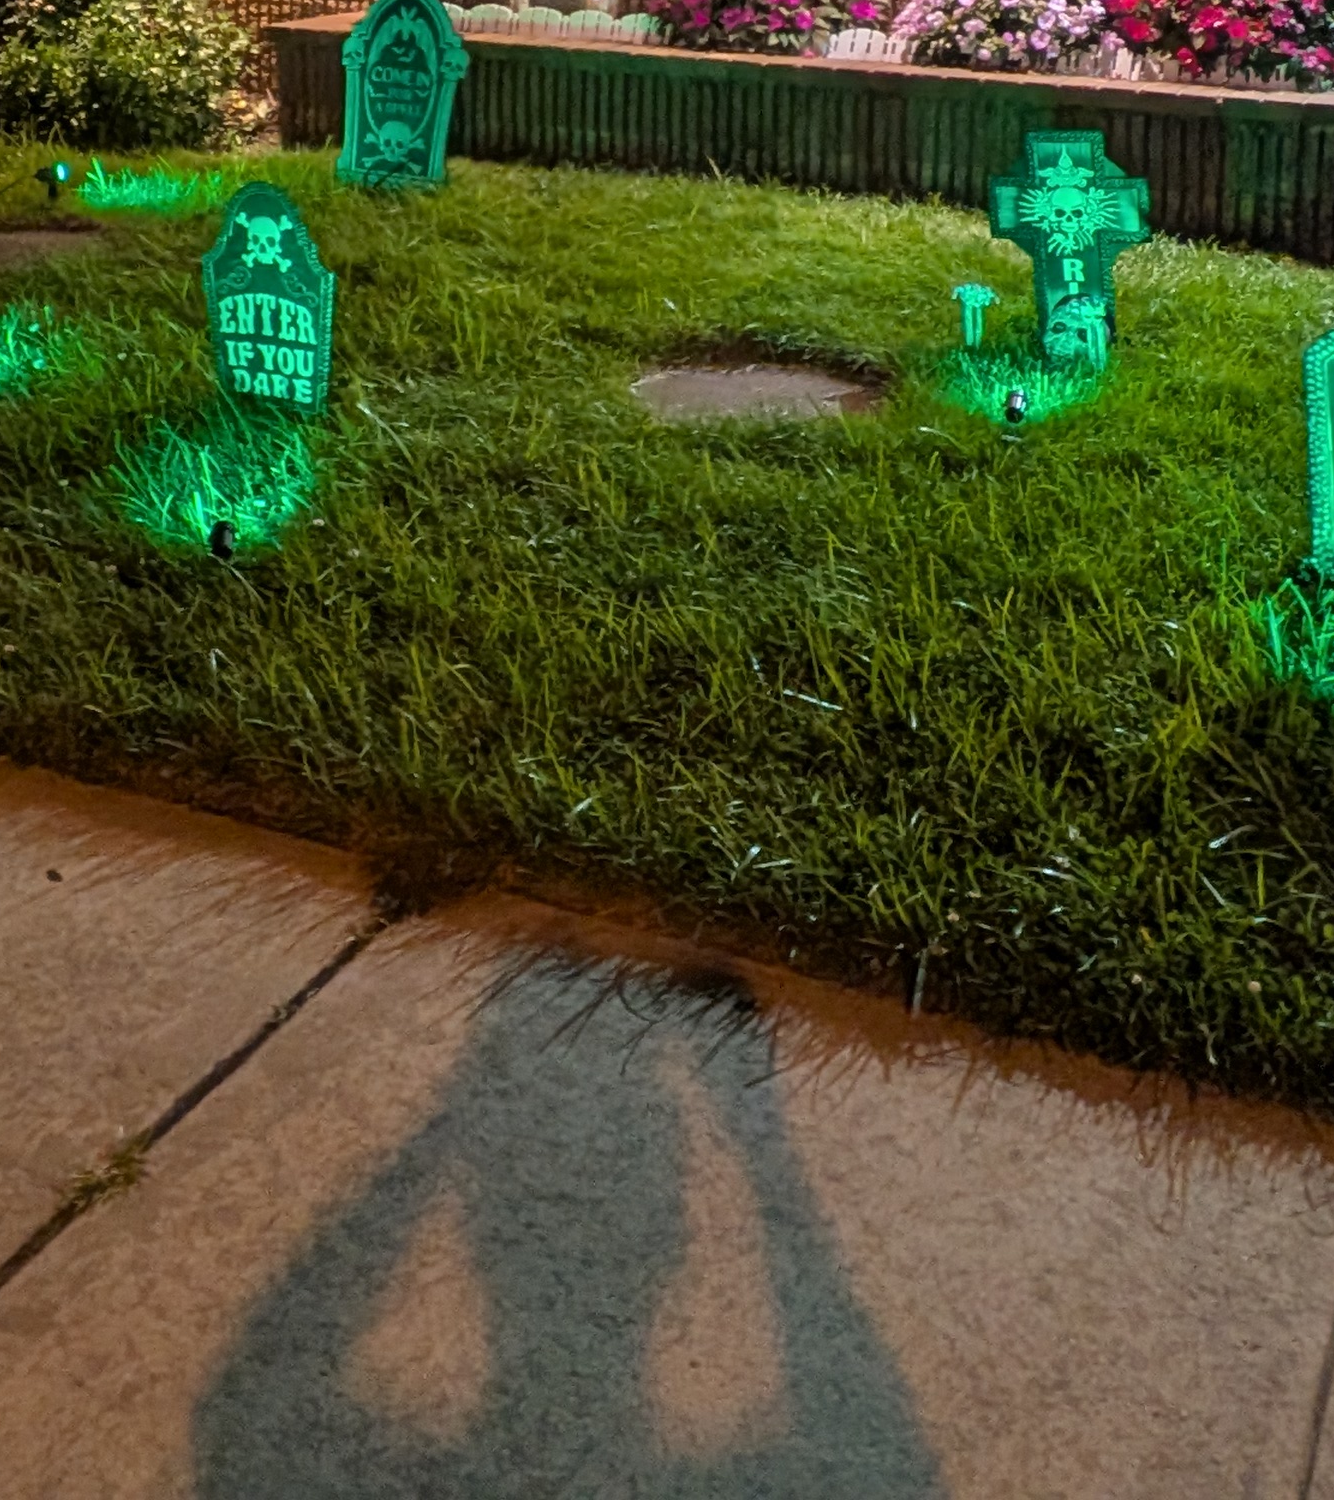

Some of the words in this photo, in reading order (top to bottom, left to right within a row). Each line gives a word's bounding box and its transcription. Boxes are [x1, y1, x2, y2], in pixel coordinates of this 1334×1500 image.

[371, 65, 415, 86] COME
[218, 292, 318, 345] ENTER
[225, 340, 255, 367] IF
[256, 343, 315, 378] YOU
[232, 368, 313, 405] DARE
